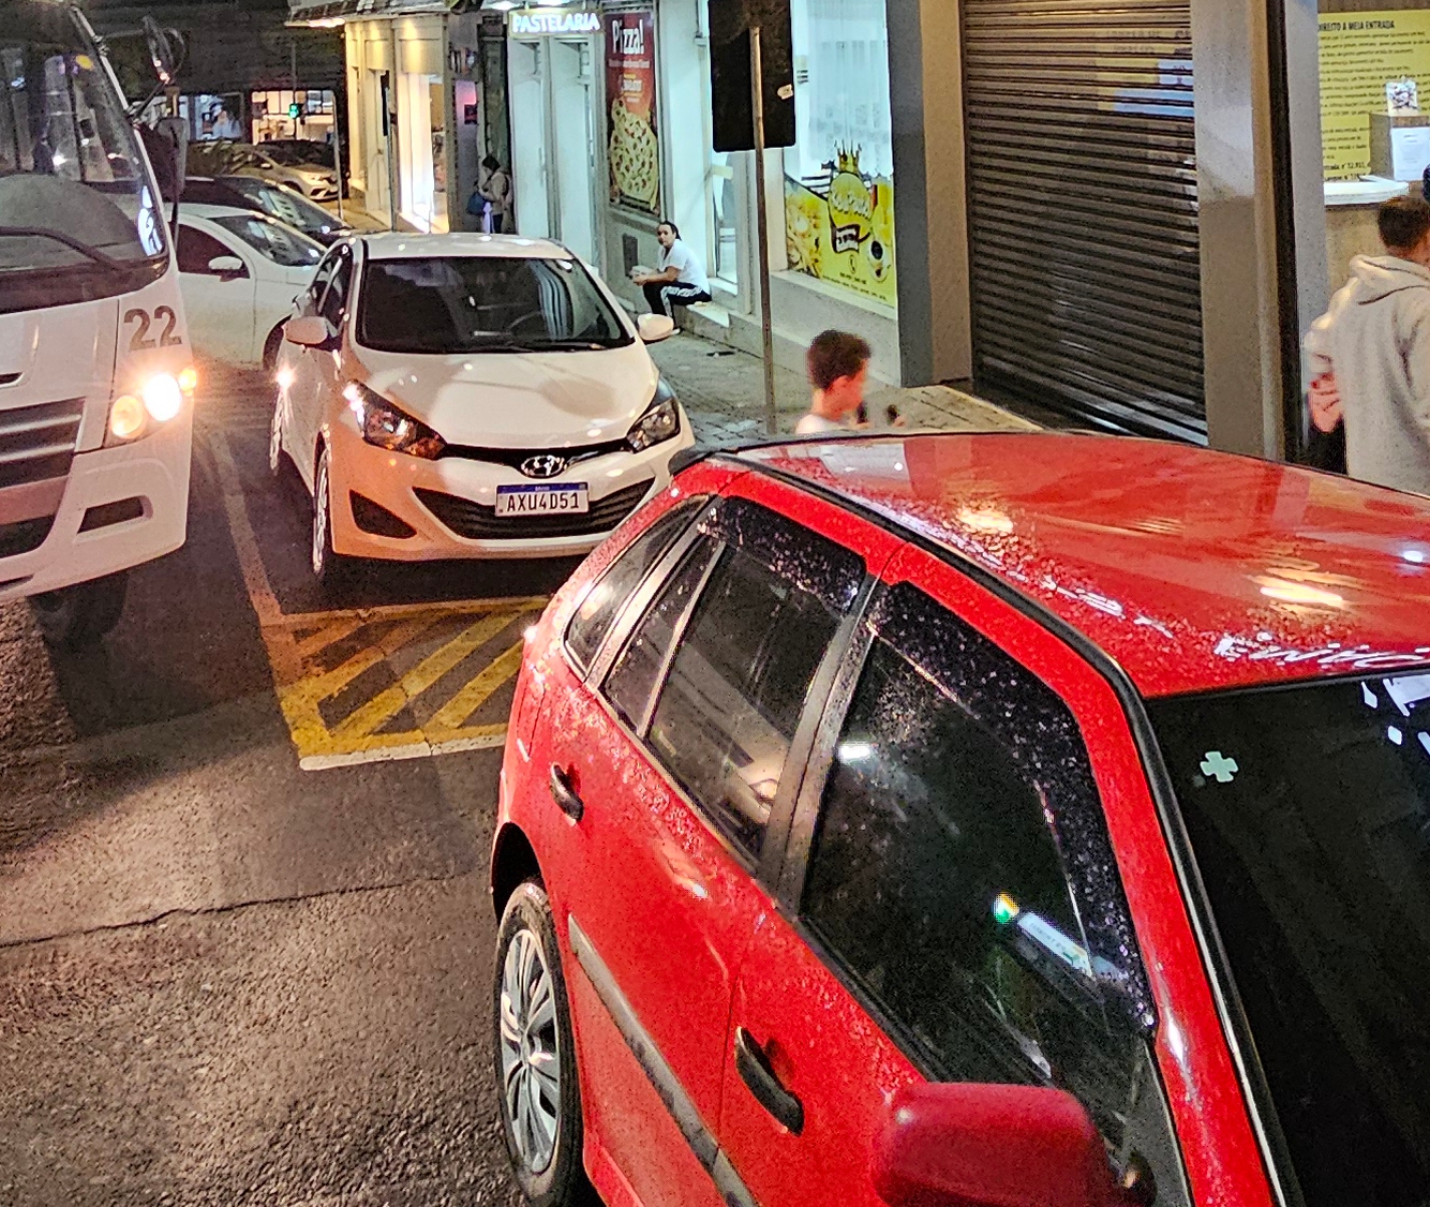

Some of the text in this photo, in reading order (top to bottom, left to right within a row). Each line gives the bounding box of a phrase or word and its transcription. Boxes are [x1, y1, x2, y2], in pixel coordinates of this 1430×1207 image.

[511, 12, 601, 33] PASTELARIA
[612, 19, 645, 55] Pizza!
[123, 304, 183, 352] 22
[506, 491, 581, 513] AXU4D51
